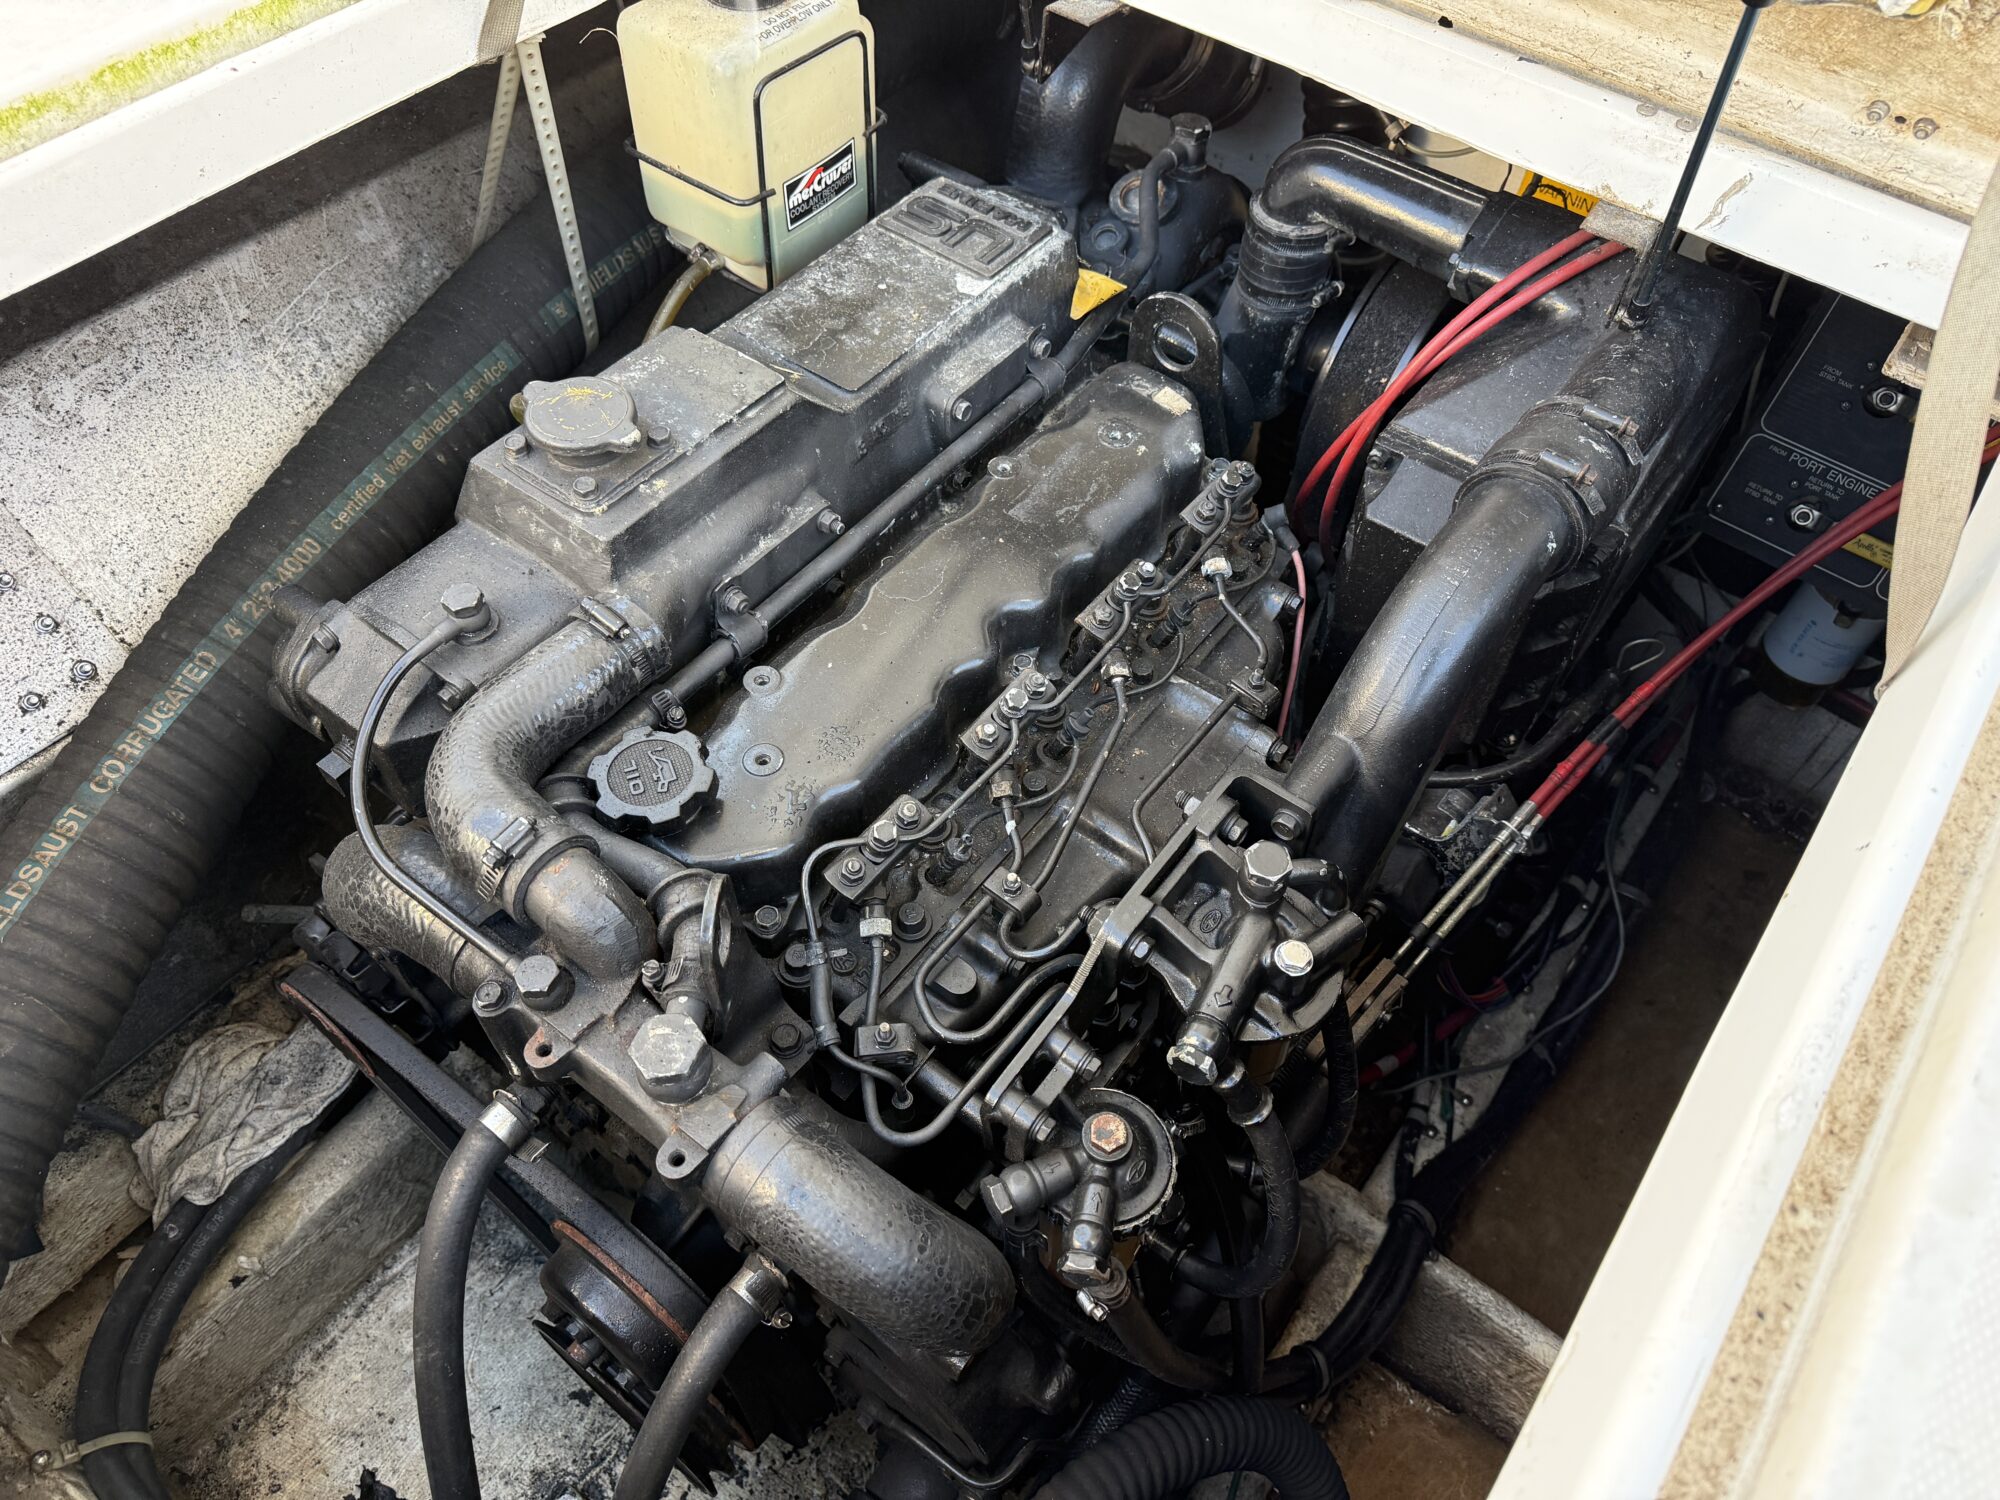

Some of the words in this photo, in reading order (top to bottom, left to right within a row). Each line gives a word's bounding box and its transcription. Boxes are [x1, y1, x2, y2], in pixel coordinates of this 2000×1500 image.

[763, 15, 777, 26] DO
[776, 8, 793, 20] NOT
[790, 193, 821, 218] COOLANT
[822, 171, 854, 198] RECOVERY
[812, 192, 836, 211] SYSTEM
[1768, 444, 1788, 457] FROM
[1789, 452, 1826, 475] PORT
[1826, 469, 1880, 500] ENGINE
[1808, 475, 1835, 491] RETURN
[1747, 481, 1774, 498] RETURN
[89, 650, 218, 795] CORRUGATED
[331, 473, 385, 531] certified
[386, 449, 414, 478] wet
[411, 405, 463, 452] exhaust
[462, 357, 508, 404] service
[623, 760, 645, 796] OIL
